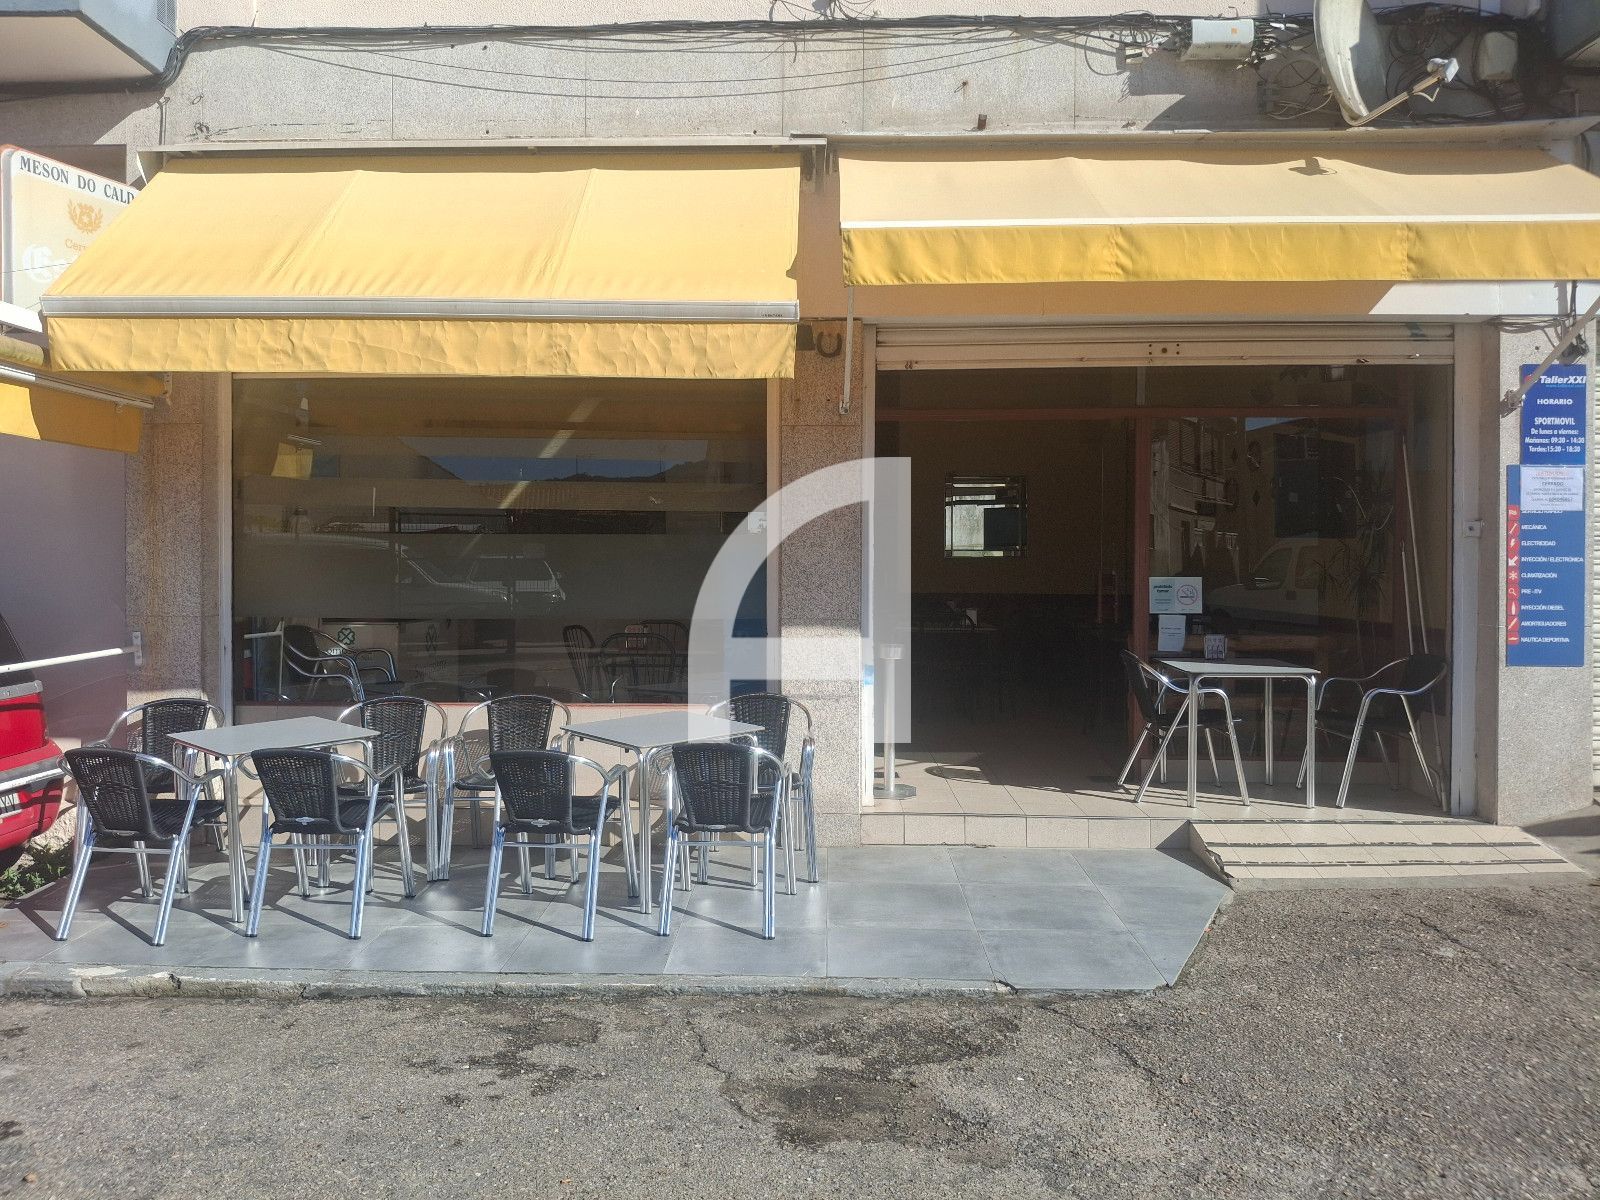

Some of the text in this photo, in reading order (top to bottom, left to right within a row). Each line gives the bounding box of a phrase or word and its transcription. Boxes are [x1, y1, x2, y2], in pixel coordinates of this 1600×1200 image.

[20, 155, 69, 185] MESON
[77, 175, 96, 193] DO
[1540, 375, 1586, 384] TallerXXI
[1534, 417, 1575, 425] SPORTMOVIL
